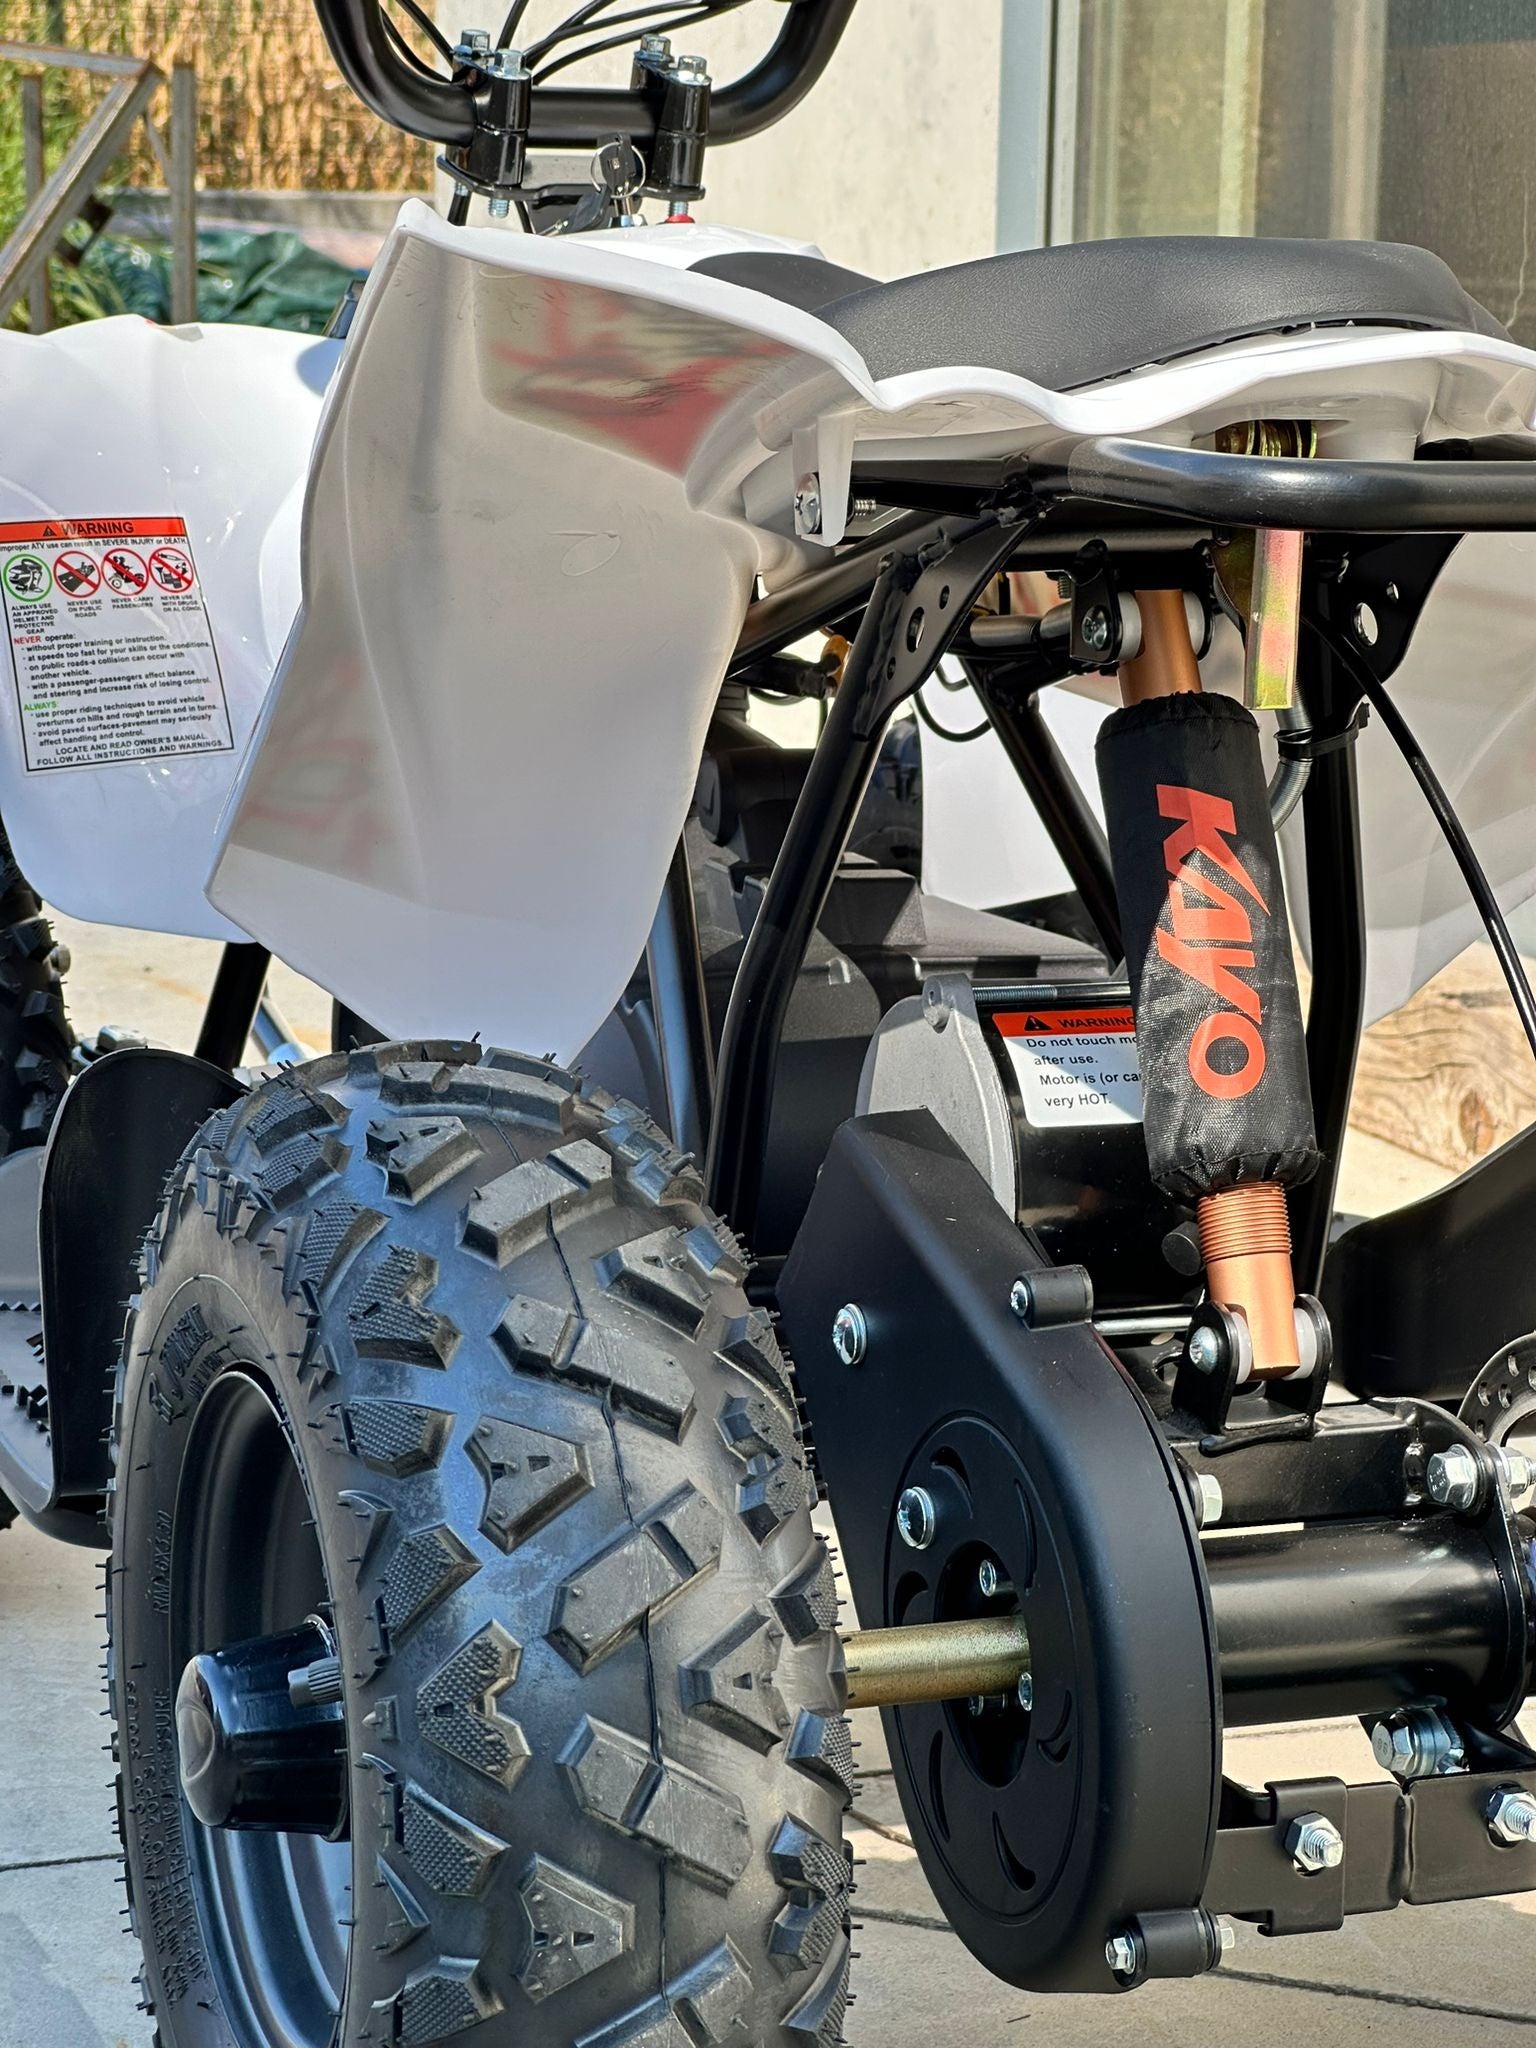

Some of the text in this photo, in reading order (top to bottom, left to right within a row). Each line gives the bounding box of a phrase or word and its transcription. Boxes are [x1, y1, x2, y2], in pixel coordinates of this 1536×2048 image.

[61, 521, 134, 536] WARNING
[102, 538, 129, 546] SEVERE
[23, 608, 58, 616] APPROVED
[14, 621, 55, 629] PROTECTIVE
[14, 633, 76, 645] NEVER operate:
[27, 644, 55, 652] without
[57, 642, 81, 650] proper
[125, 635, 167, 643] instruction.
[38, 653, 64, 661] speeds
[129, 645, 147, 653] skills
[172, 641, 210, 649] conditions.
[41, 662, 65, 671] public
[98, 656, 129, 664] collision
[31, 668, 92, 680] another vehicle.
[145, 671, 165, 679] affect
[167, 669, 195, 677] balance
[33, 677, 211, 699] and steering and increase risk of losing control.
[52, 709, 76, 717] proper
[104, 701, 145, 710] techniques
[158, 697, 177, 705] avoid
[179, 695, 204, 703] vehicle
[37, 718, 74, 727] overturns
[106, 712, 120, 720] and
[122, 710, 144, 719] rough
[147, 708, 171, 716] terrain
[38, 728, 59, 737] avoid
[62, 726, 84, 735] paved
[179, 713, 211, 722] seriously
[40, 729, 144, 746] affect handling and control.
[56, 745, 88, 755] LOCATE
[90, 743, 107, 751] AND
[110, 740, 131, 749] READ
[134, 736, 171, 746] OWNER'S
[37, 756, 73, 765] FOLLOW
[76, 753, 92, 761] ALL
[95, 746, 156, 759] INSTRUCTIONS
[159, 744, 176, 752] AND
[1155, 784, 1271, 1099] KAYO
[1026, 1038, 1046, 1048] Do
[1050, 1037, 1073, 1046] not
[1076, 1035, 1115, 1046] touch
[1034, 1055, 1099, 1066] after use.
[1040, 1071, 1142, 1086] Motor is (or ca
[1045, 1092, 1112, 1108] very HOT.
